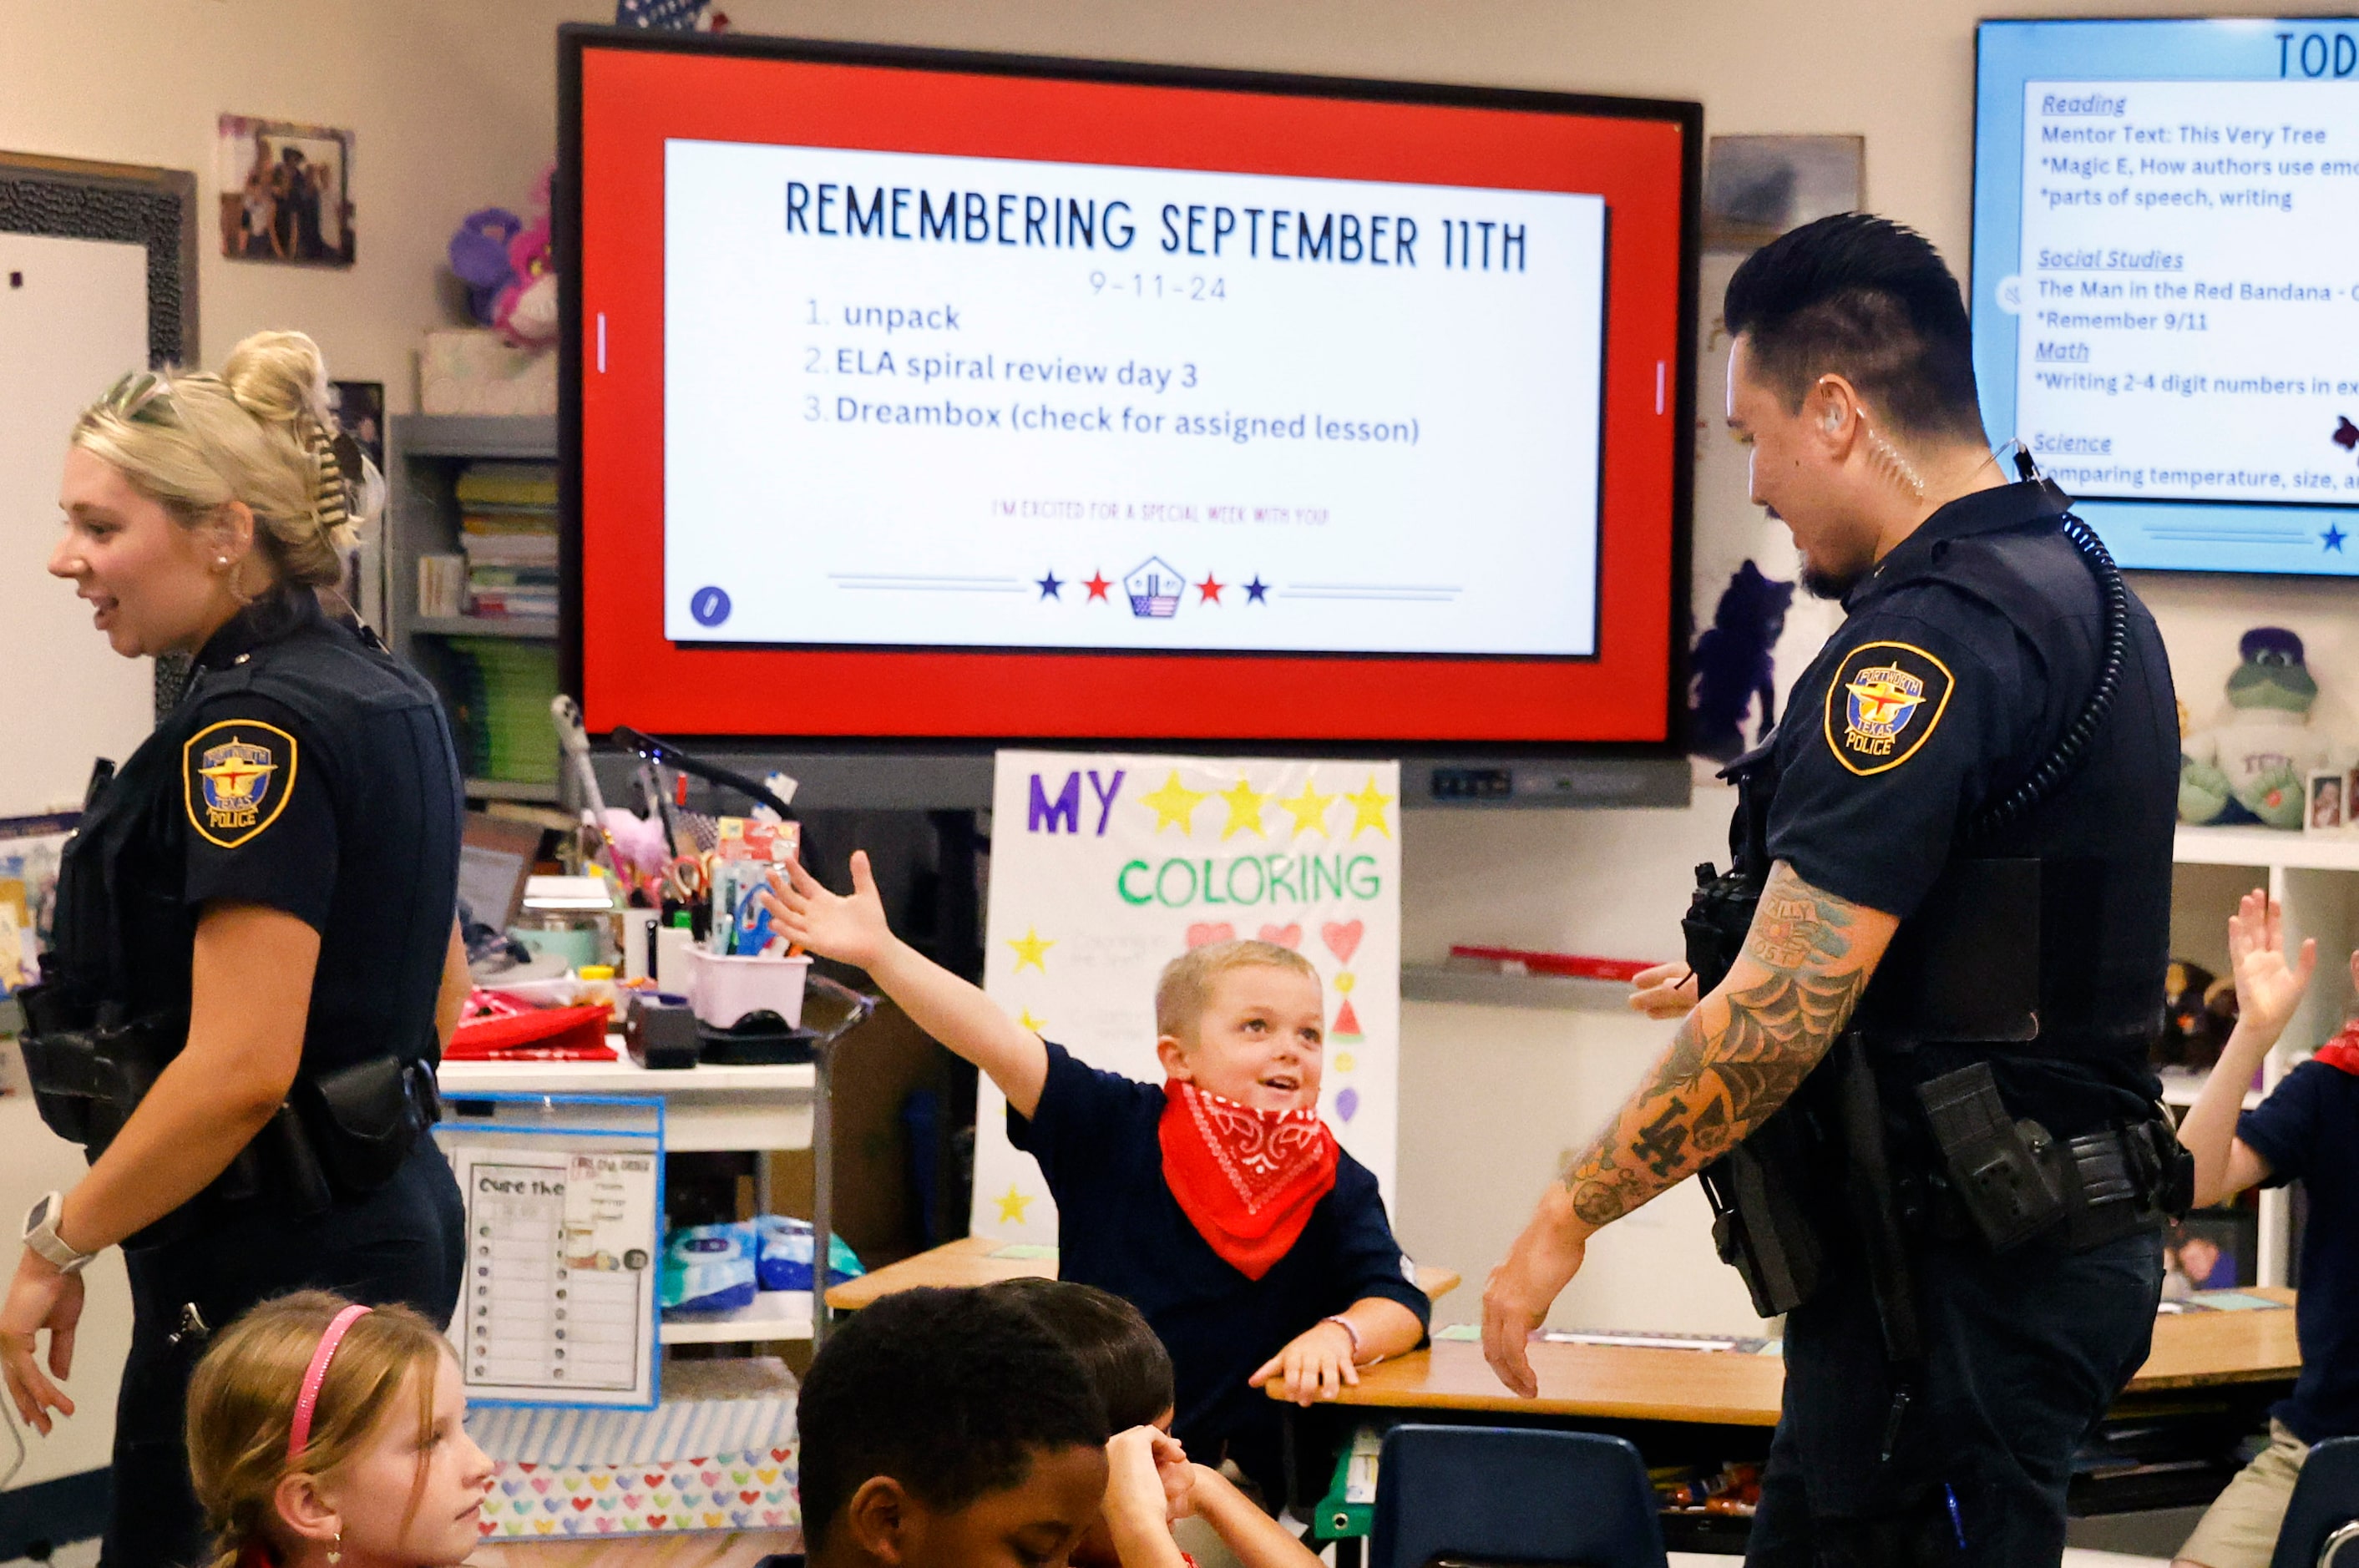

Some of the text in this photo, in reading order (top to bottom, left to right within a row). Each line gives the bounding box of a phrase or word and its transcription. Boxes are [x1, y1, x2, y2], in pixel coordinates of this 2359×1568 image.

[2042, 94, 2127, 117] Reading
[2042, 126, 2326, 149] Mentor Text: This Very Tree
[2117, 159, 2134, 177] E,
[2140, 159, 2185, 175] How
[2191, 158, 2272, 175] authors
[2278, 162, 2314, 175] use
[2108, 188, 2129, 206] of
[2135, 189, 2214, 210] speech,
[2220, 189, 2293, 212] writing
[787, 181, 1526, 272] REMEMBERING SEPTEMBER 11TH
[2038, 250, 2184, 271] Social Studies
[1089, 271, 1228, 301] 9-11-24
[2038, 280, 2074, 298] The
[2080, 281, 2123, 298] Man
[2129, 281, 2149, 299] in
[2154, 281, 2188, 299] the
[2193, 282, 2233, 300] Red
[2240, 283, 2331, 301] Bandana
[805, 297, 960, 333] 1. unpack
[2164, 312, 2209, 332] 9/11
[2034, 341, 2090, 362] Math
[804, 346, 1199, 393] 2. ELA spiral review day 3
[2123, 373, 2156, 391] 2-4
[2161, 373, 2208, 397] digit
[2213, 375, 2306, 395] numbers
[2311, 377, 2331, 394] in
[803, 395, 1420, 446] 3. Dreambox (check for assigned lesson)
[2033, 433, 2113, 455] Science
[2150, 466, 2287, 489] temperature,
[2292, 469, 2337, 491] size,
[1022, 499, 1085, 518] EXCITED
[1091, 501, 1120, 519] FOR
[1125, 503, 1136, 520] A
[1142, 503, 1200, 523] SPECIAL
[1207, 505, 1247, 524] WEEK
[1253, 505, 1290, 524] WITH
[1857, 719, 1894, 735] TEXAS
[1845, 732, 1892, 756] POLICE
[215, 795, 254, 809] TEXAS
[1027, 769, 1125, 837] MY
[210, 811, 256, 828] POLICE
[1116, 853, 1381, 908] COLORING
